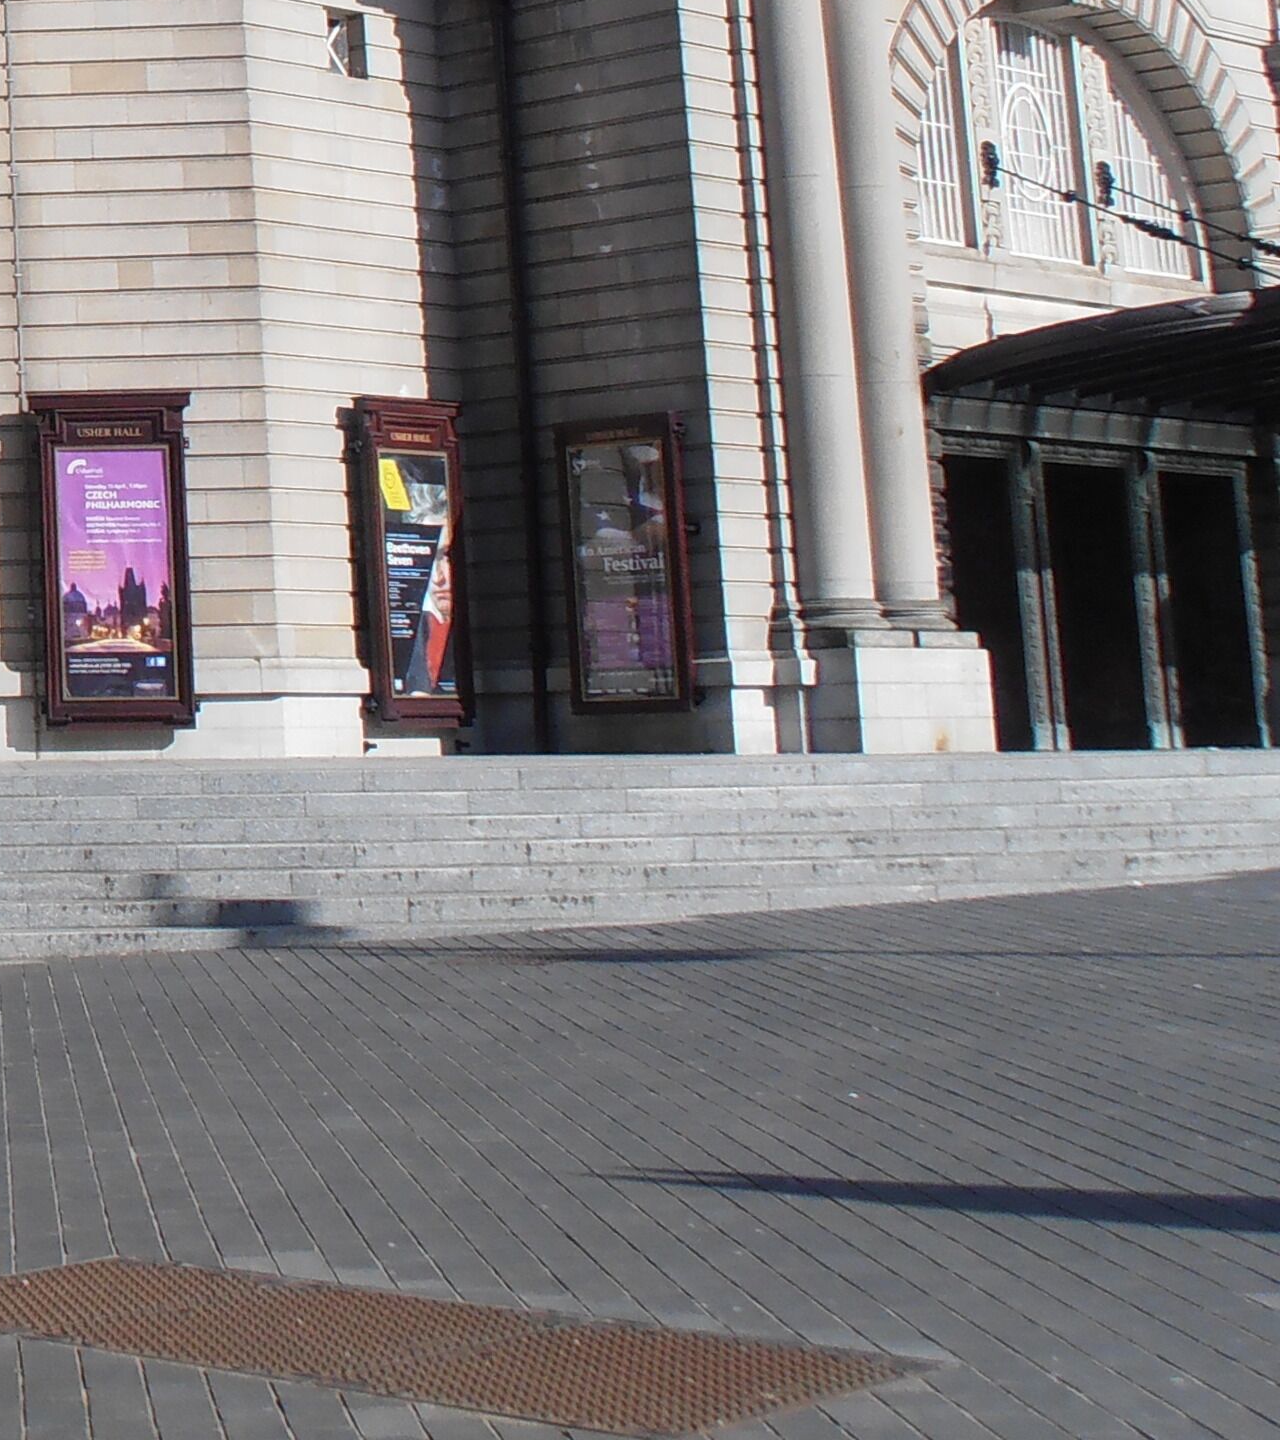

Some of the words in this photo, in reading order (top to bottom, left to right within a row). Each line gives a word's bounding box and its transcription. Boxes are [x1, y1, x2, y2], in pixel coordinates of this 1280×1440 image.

[76, 428, 112, 437] USHER
[113, 427, 143, 437] HALL
[413, 434, 432, 443] HALL
[85, 491, 117, 499] CZECH
[85, 500, 160, 509] PHILHARMONIC
[386, 542, 432, 555] Beethoven
[597, 544, 647, 556] American
[387, 554, 414, 566] Seven
[603, 552, 665, 572] Festival
